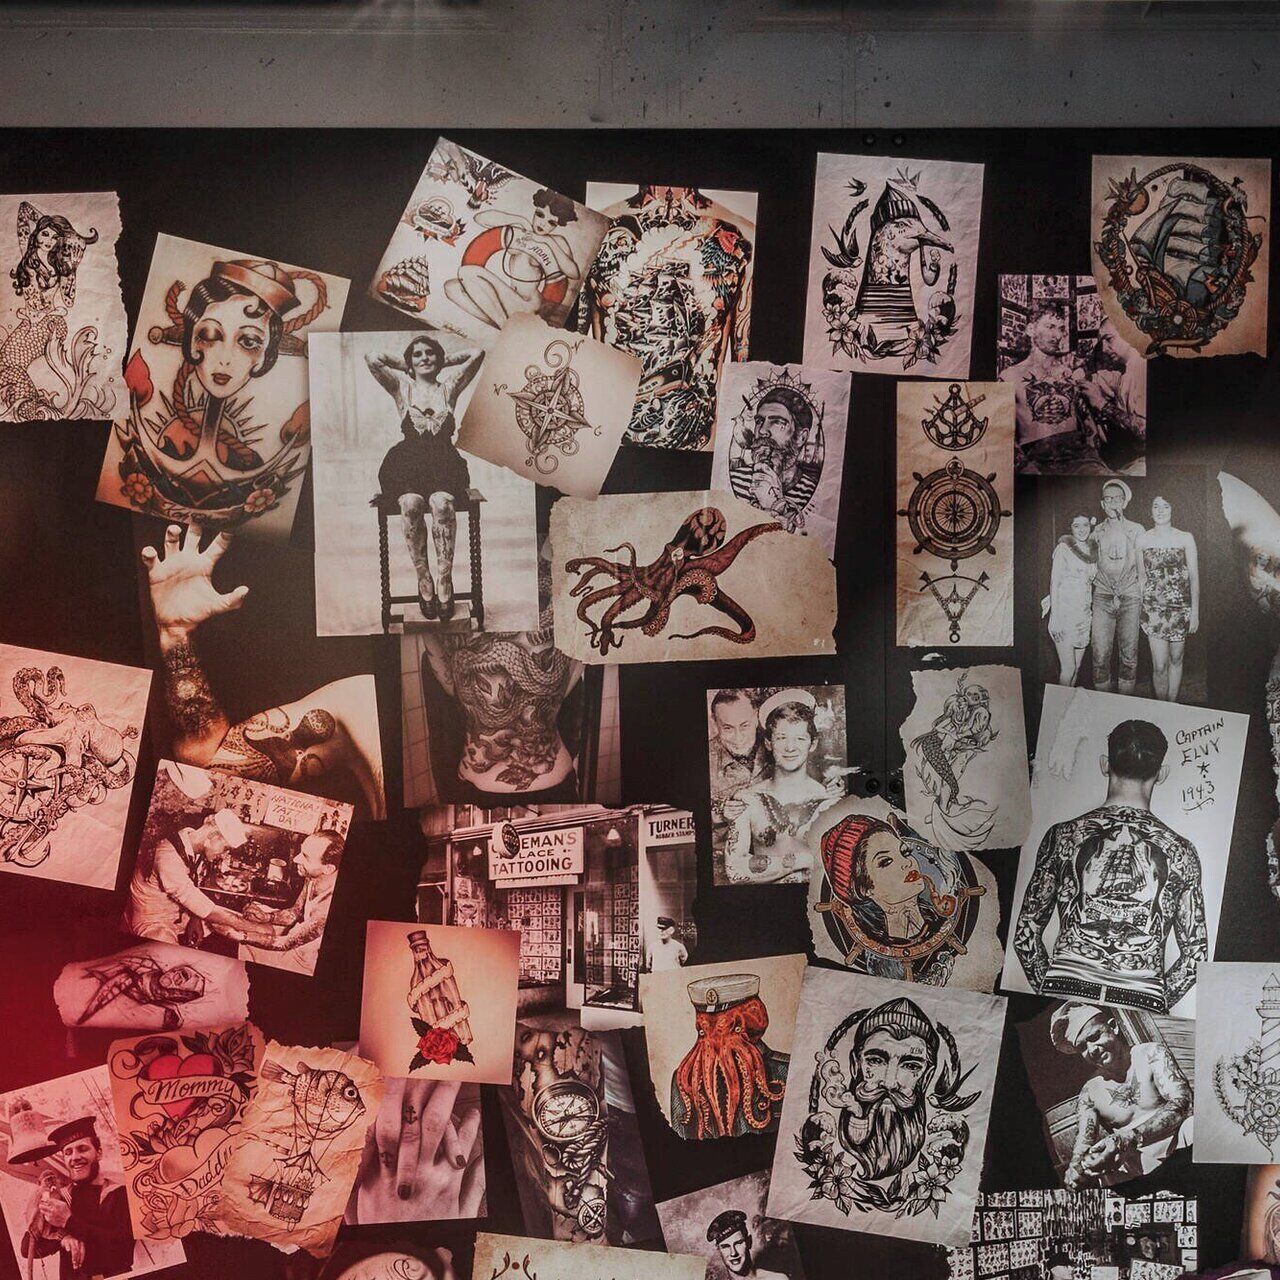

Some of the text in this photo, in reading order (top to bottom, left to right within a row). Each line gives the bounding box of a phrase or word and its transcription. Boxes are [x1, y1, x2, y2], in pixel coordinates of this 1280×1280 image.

[1175, 717, 1224, 745] CAPTAIN
[1181, 737, 1220, 766] ELVY
[1182, 780, 1214, 802] 1943
[649, 816, 695, 837] TURNER
[518, 850, 555, 859] LACE
[492, 857, 573, 875] TATTOOING
[148, 1080, 235, 1102] Mommy
